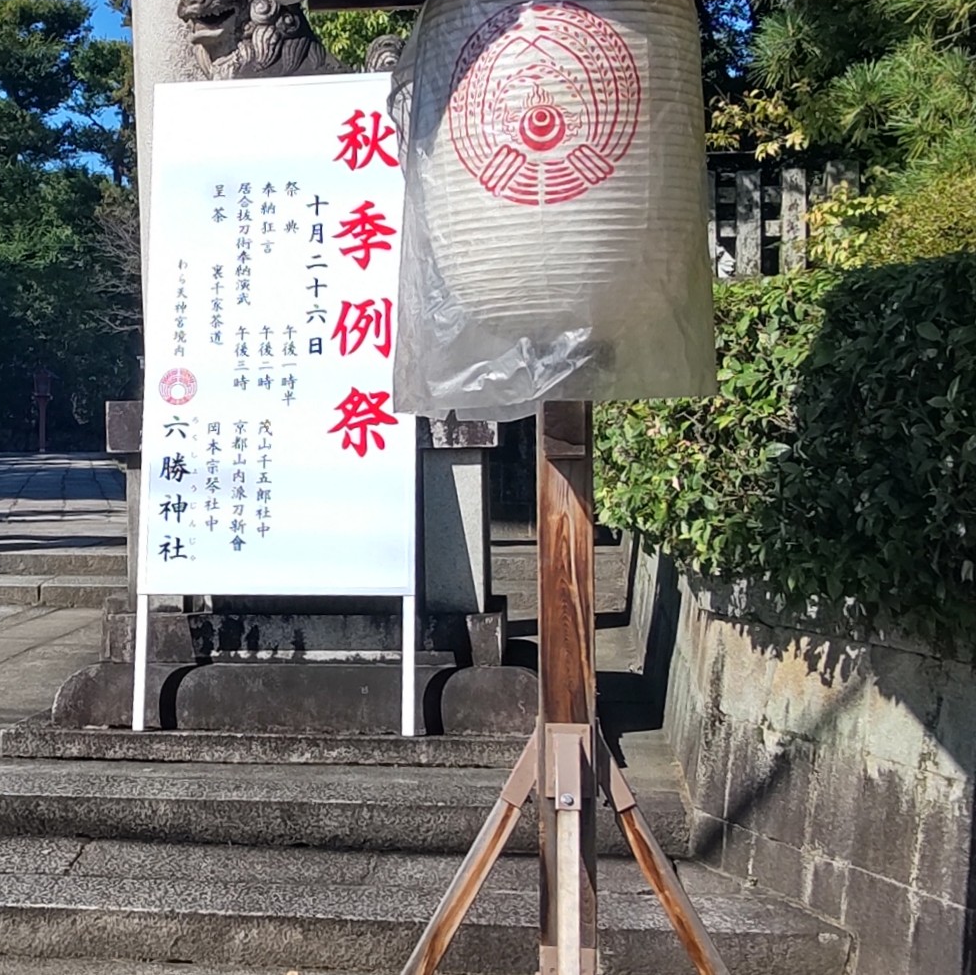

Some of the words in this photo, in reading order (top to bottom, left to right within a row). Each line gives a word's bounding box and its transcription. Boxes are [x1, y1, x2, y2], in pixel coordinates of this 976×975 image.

[211, 184, 228, 223] 呈茶
[235, 182, 254, 306] 居合抜刀術奉納演武
[260, 181, 277, 254] 奉納狂言
[284, 181, 300, 234] 祭典
[173, 258, 189, 357] わら天神宮境内
[210, 264, 225, 345] 裏千家茶道
[306, 194, 329, 355] 十月二十六日
[328, 109, 399, 457] 秋季例祭
[233, 325, 250, 390] 午後三時
[258, 325, 274, 390] 午後二時
[281, 324, 298, 406] 午後一時半
[158, 415, 191, 562] 六勝神社
[256, 419, 273, 538] 茂山千五郎社中
